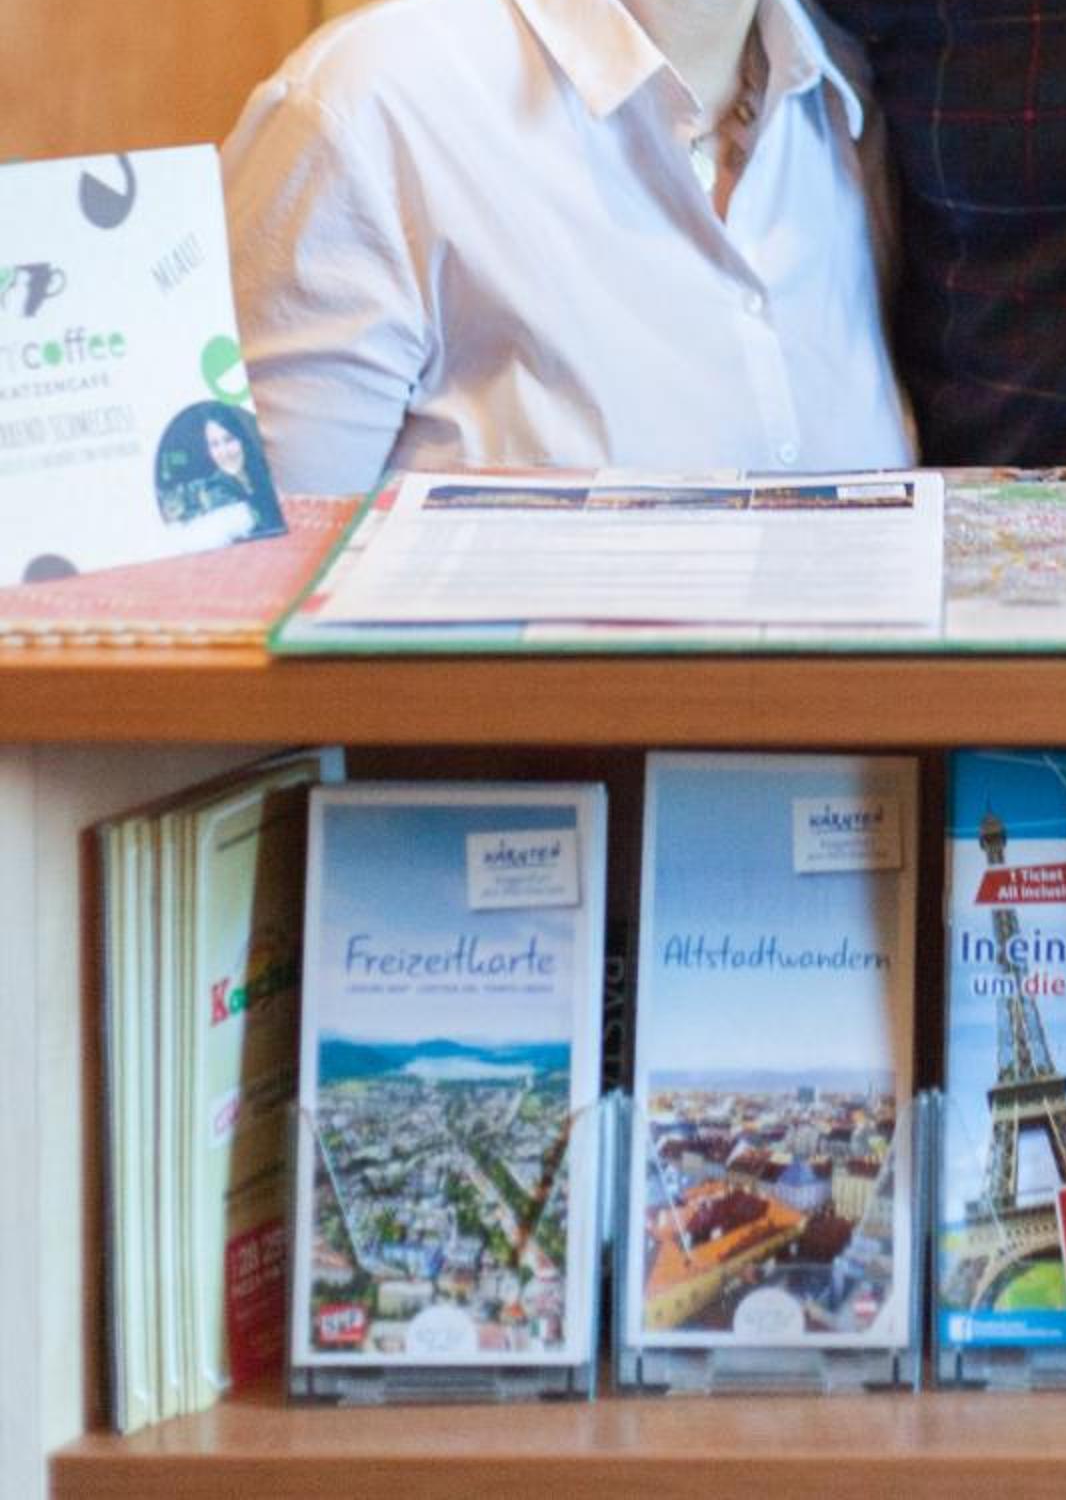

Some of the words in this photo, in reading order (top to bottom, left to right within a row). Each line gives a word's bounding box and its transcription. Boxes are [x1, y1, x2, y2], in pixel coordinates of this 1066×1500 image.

[1022, 870, 1065, 884] Ticket
[345, 933, 555, 977] Freizeitkarte
[663, 934, 890, 970] Altstadtwandern
[961, 932, 995, 964] In
[973, 974, 1014, 997] um
[1024, 971, 1066, 997] die
